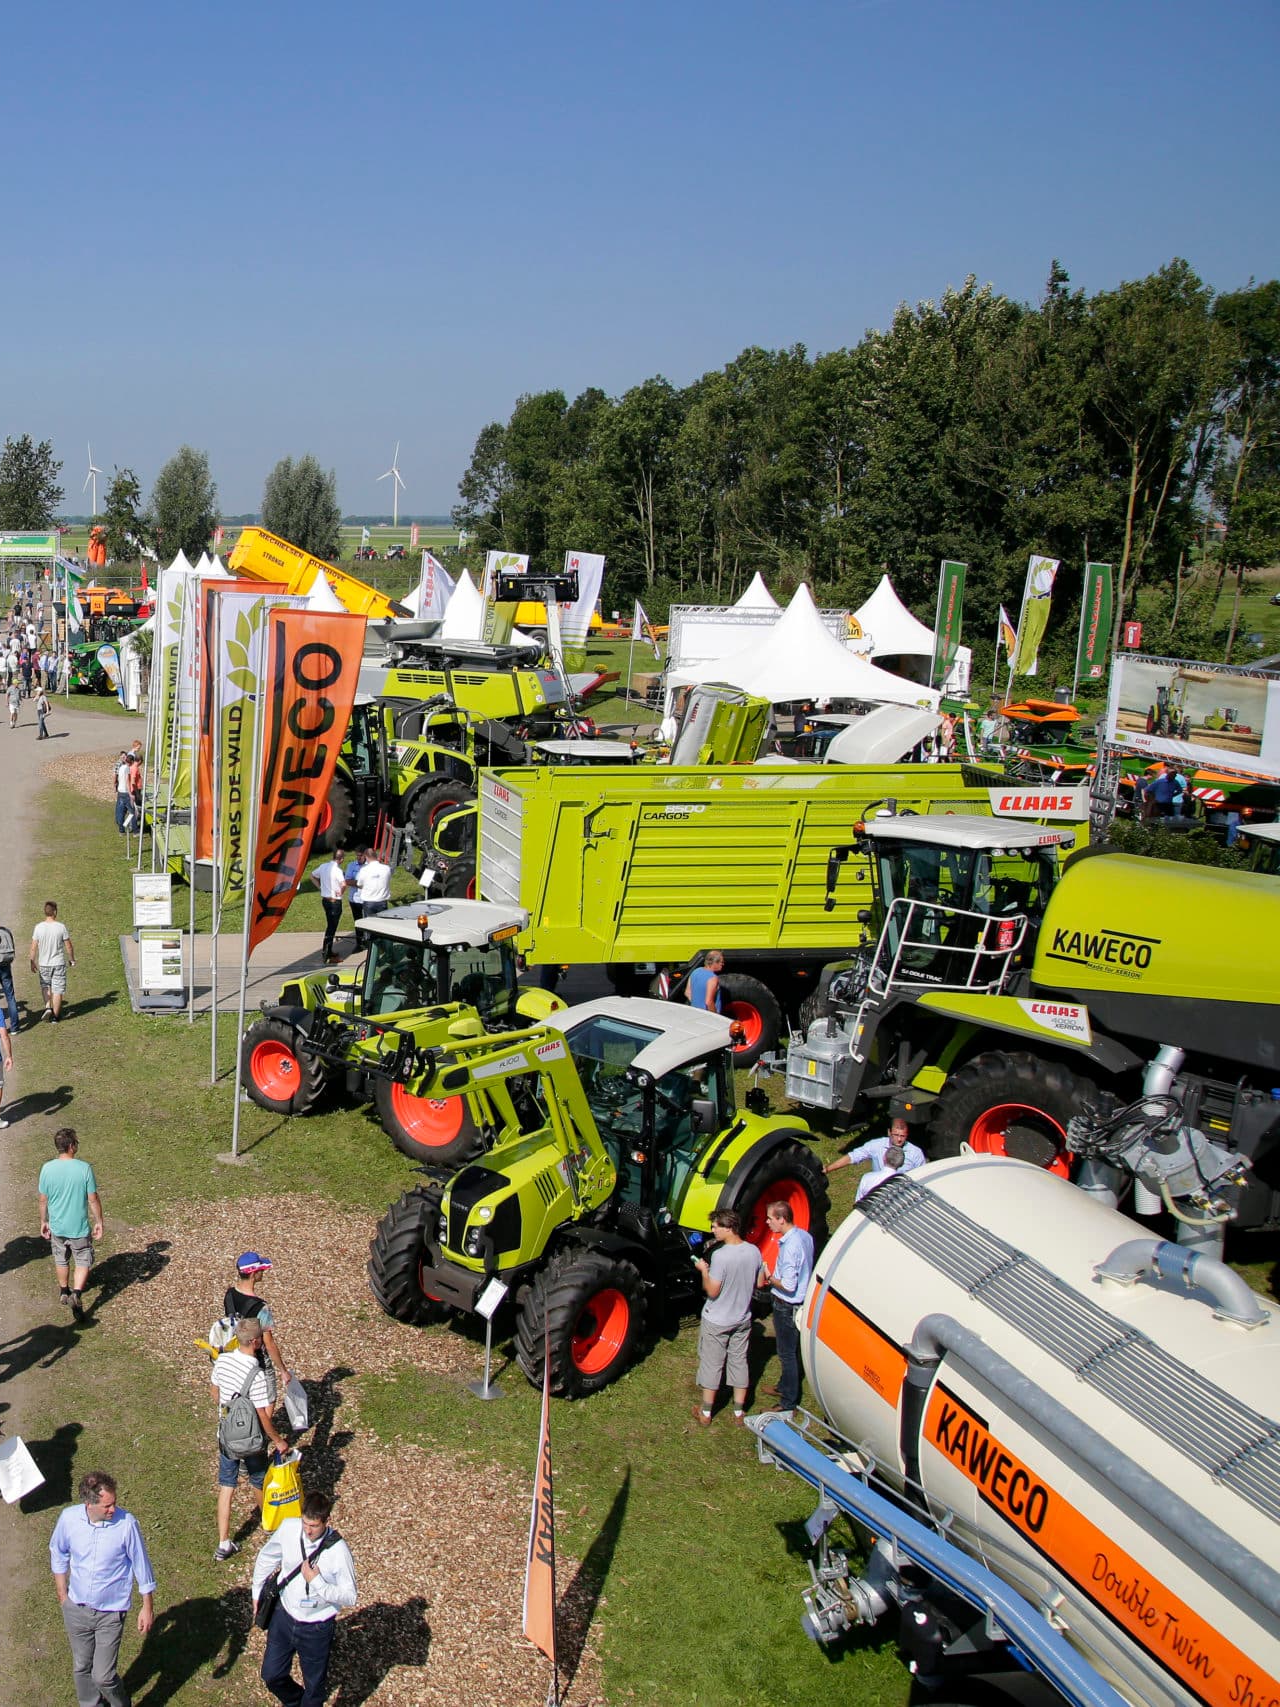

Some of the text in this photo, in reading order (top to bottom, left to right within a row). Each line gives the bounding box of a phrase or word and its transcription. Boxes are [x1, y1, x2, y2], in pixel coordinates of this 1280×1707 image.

[255, 641, 343, 926] KAWECO
[228, 705, 244, 892] KAMPS DE WILD
[998, 796, 1074, 811] CLAAS
[643, 812, 690, 820] CARGOS
[665, 804, 706, 814] 8500
[1038, 834, 1062, 845] CLAAS
[1052, 927, 1153, 969] KAWECO
[1031, 1003, 1080, 1018] CLAAS
[1051, 1017, 1077, 1025] 4000
[1055, 1023, 1085, 1032] XERION
[537, 1040, 561, 1056] CLAAS
[935, 1402, 1050, 1533] KAWECO
[1091, 1552, 1157, 1629] Double
[1155, 1612, 1216, 1680] Twin
